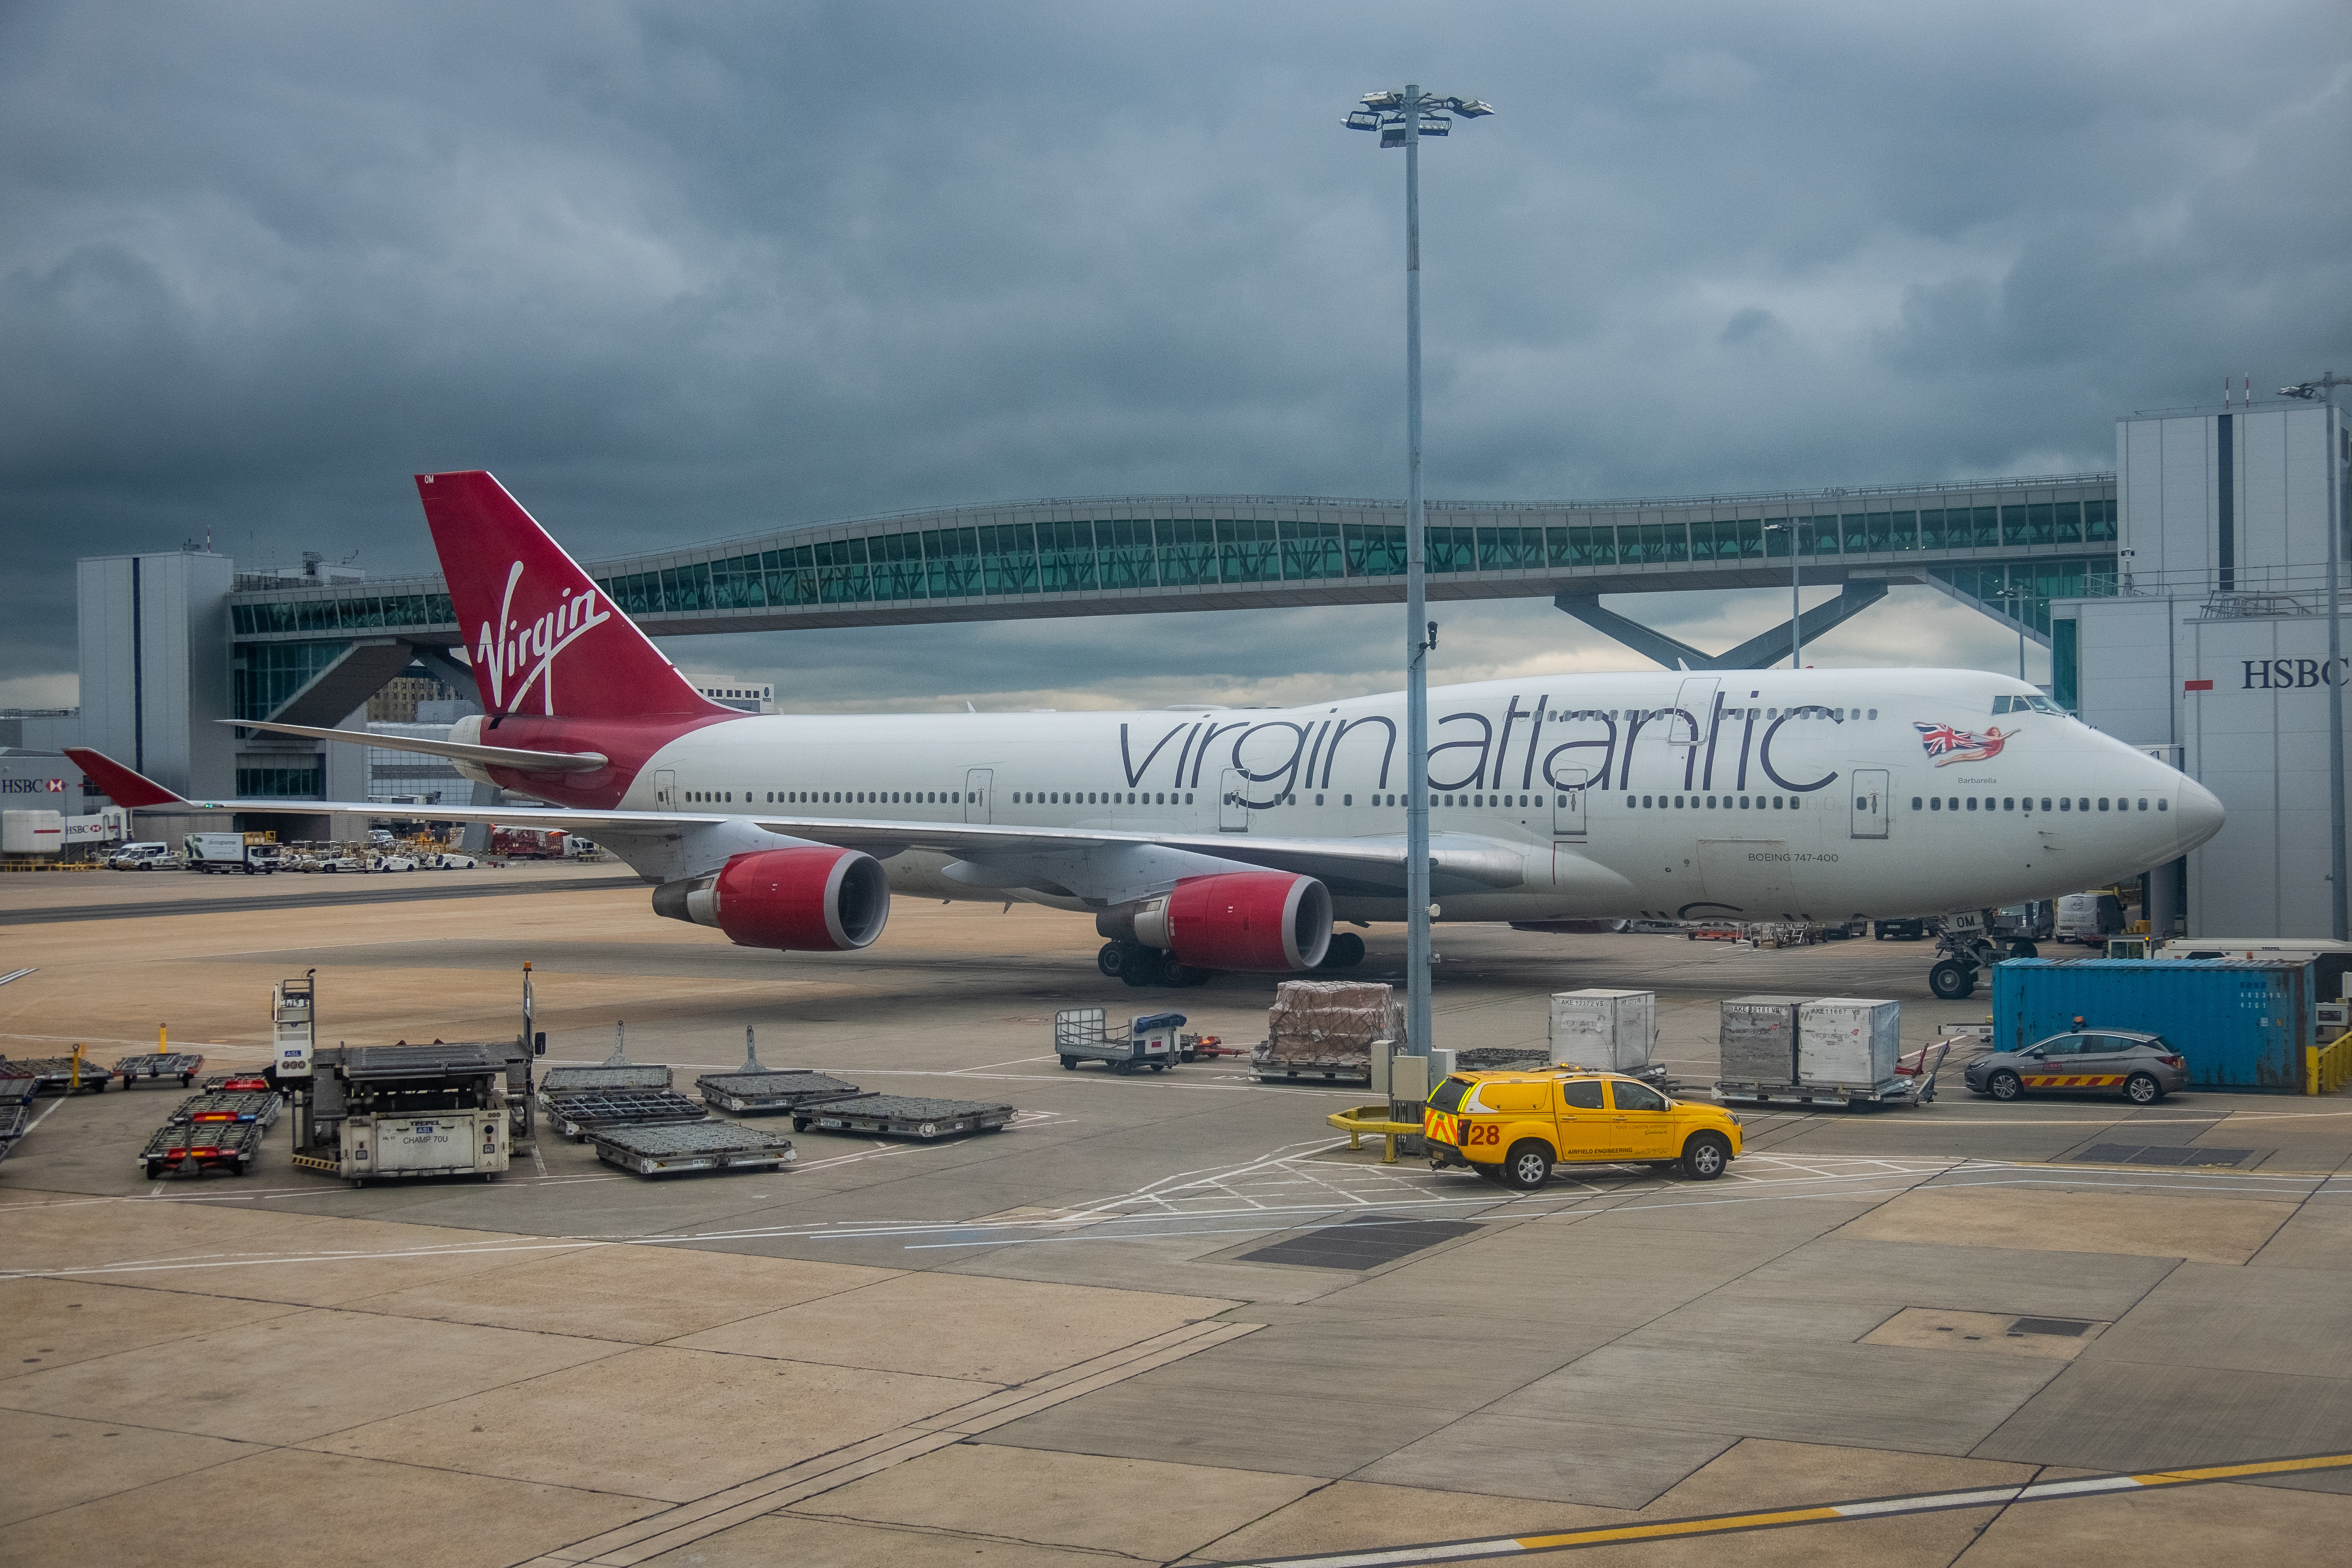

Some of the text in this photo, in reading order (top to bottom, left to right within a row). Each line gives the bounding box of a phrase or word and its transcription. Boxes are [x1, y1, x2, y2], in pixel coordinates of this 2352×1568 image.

[424, 474, 434, 484] OM
[477, 561, 610, 716] Virgin
[2241, 657, 2350, 689] HSBC
[1120, 690, 1844, 810] virgin atlantic
[2, 779, 43, 793] HSBC
[67, 825, 89, 835] HSBC
[1748, 853, 1838, 862] BOEING 747-400
[1956, 915, 1975, 928] OM
[1470, 1125, 1500, 1145] 28
